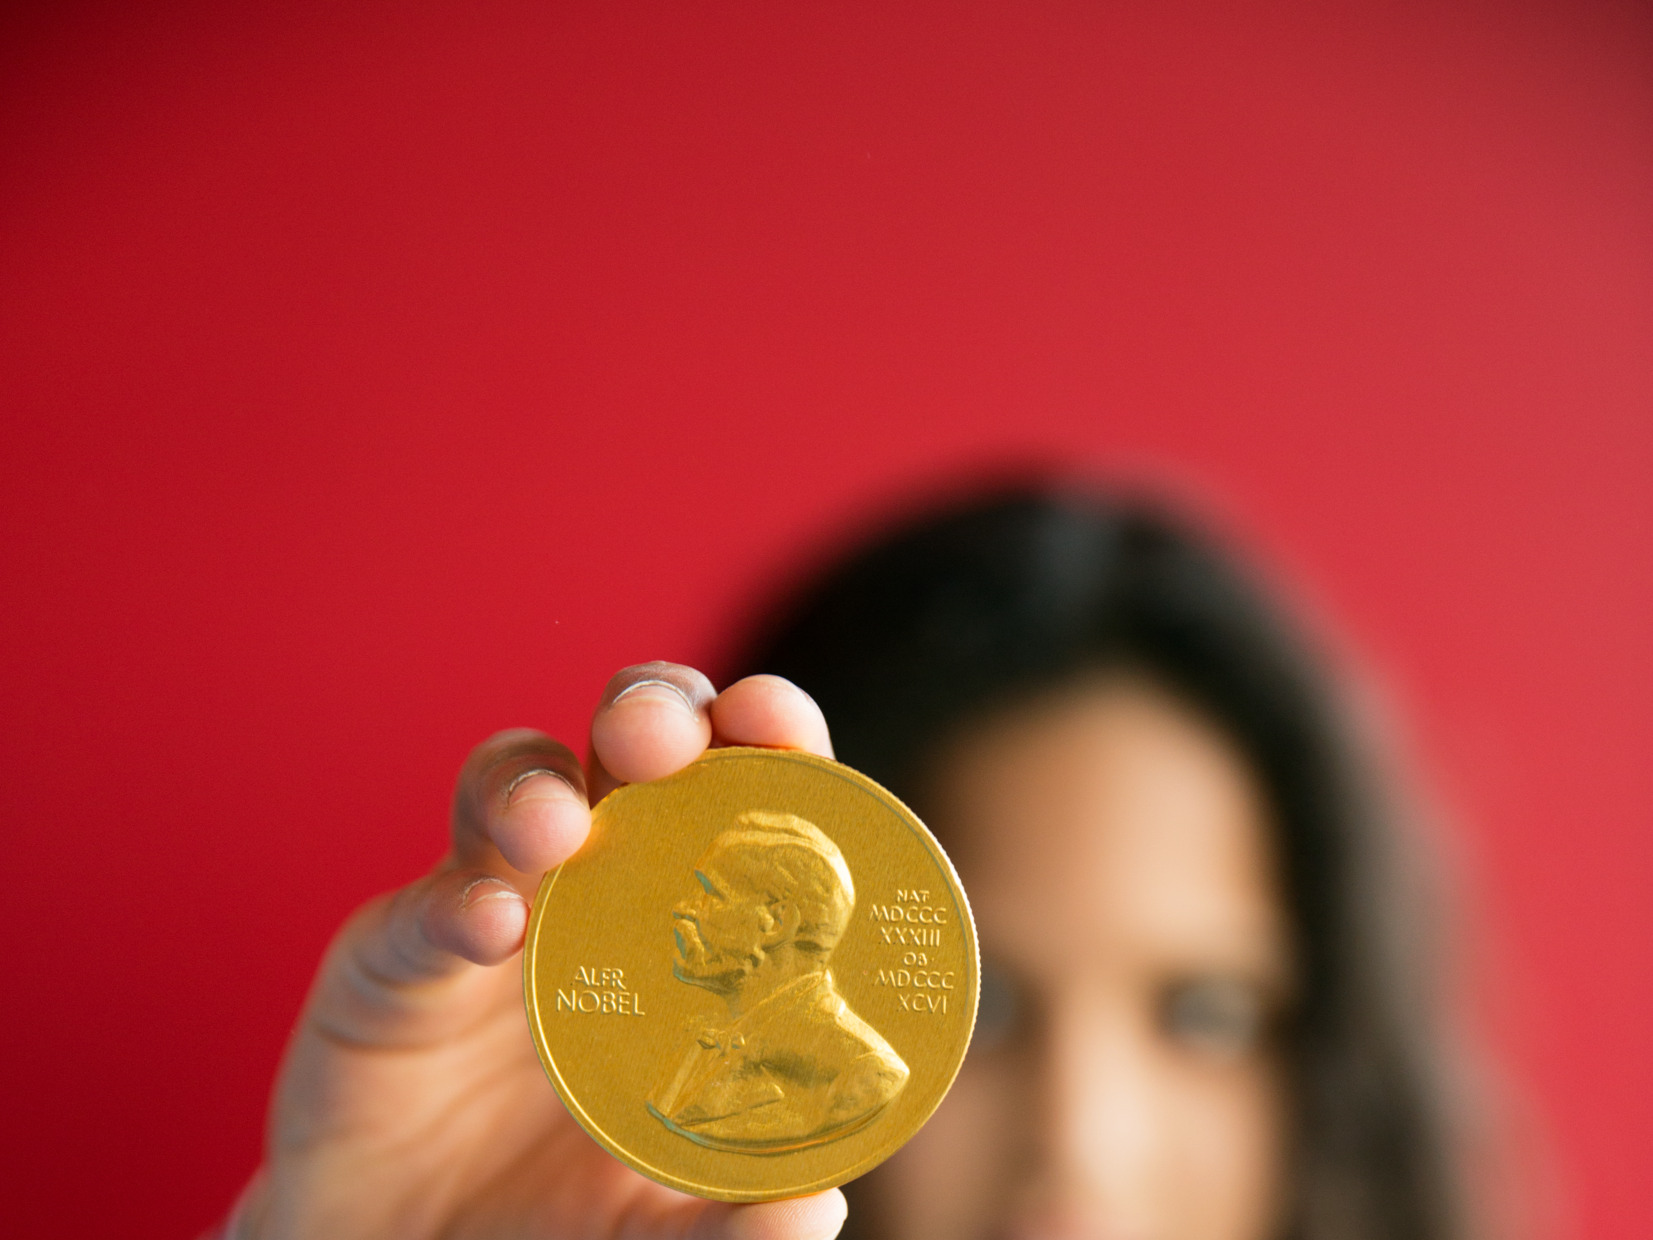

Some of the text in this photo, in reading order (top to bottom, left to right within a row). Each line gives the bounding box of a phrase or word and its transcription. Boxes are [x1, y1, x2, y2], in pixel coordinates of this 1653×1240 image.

[896, 889, 930, 903] NAT
[869, 904, 947, 924] MDCCC
[878, 926, 940, 947] XXXIII
[571, 966, 627, 989] ALFR
[873, 969, 954, 989] MDCCC
[555, 988, 645, 1015] NOBEL
[897, 993, 947, 1014] XCVI
